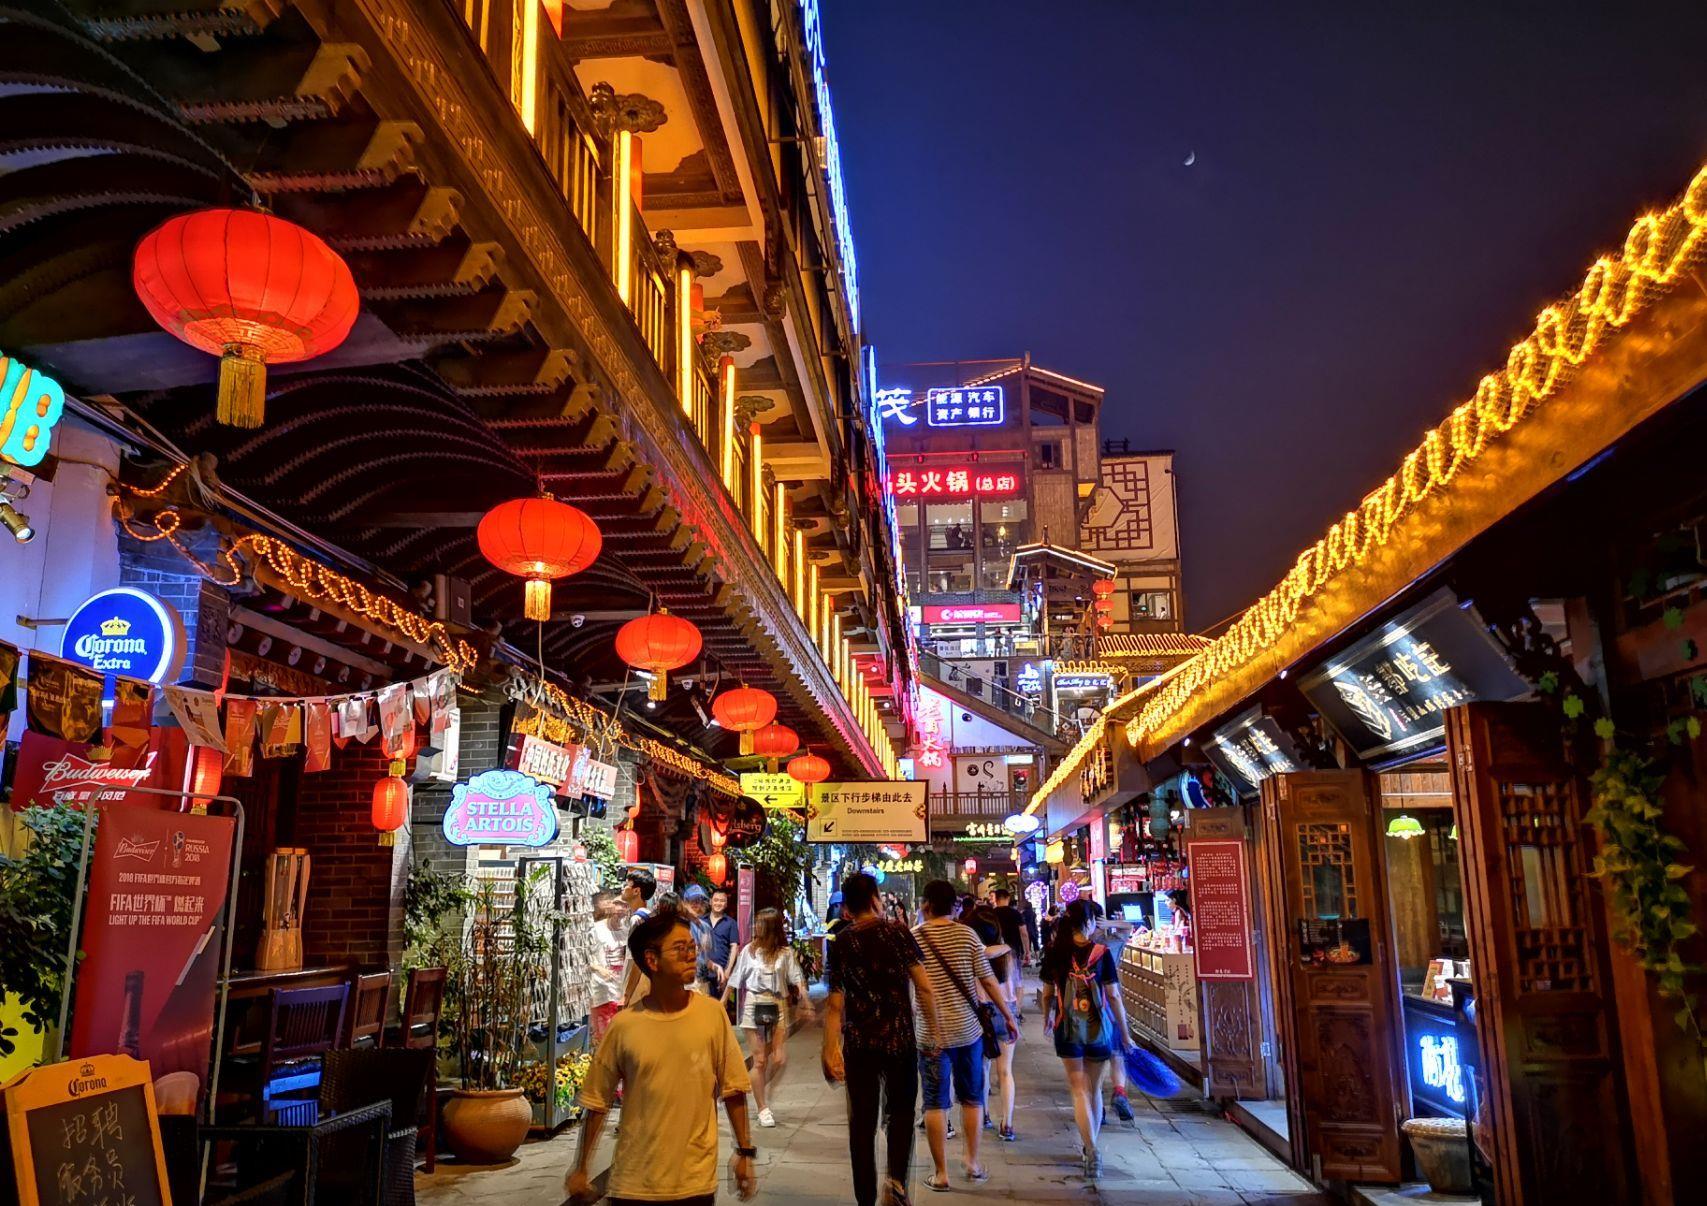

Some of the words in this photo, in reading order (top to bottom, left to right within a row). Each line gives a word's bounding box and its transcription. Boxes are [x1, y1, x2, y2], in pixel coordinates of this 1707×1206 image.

[74, 633, 148, 660] Corona
[93, 653, 131, 670] Extra
[820, 792, 913, 804] 景区下行步梯由此去
[466, 802, 534, 816] STELLA
[847, 807, 885, 815] Downstairs
[464, 818, 535, 833] ARTOIS
[184, 844, 210, 854] RUSSIA
[184, 852, 201, 862] 2018
[118, 872, 134, 884] 2018
[108, 914, 128, 925] LIGHT
[128, 915, 138, 925] UP
[139, 915, 151, 925] THE
[151, 915, 166, 925] FIFA
[166, 915, 188, 925] WORLD
[68, 1077, 108, 1097] Corona
